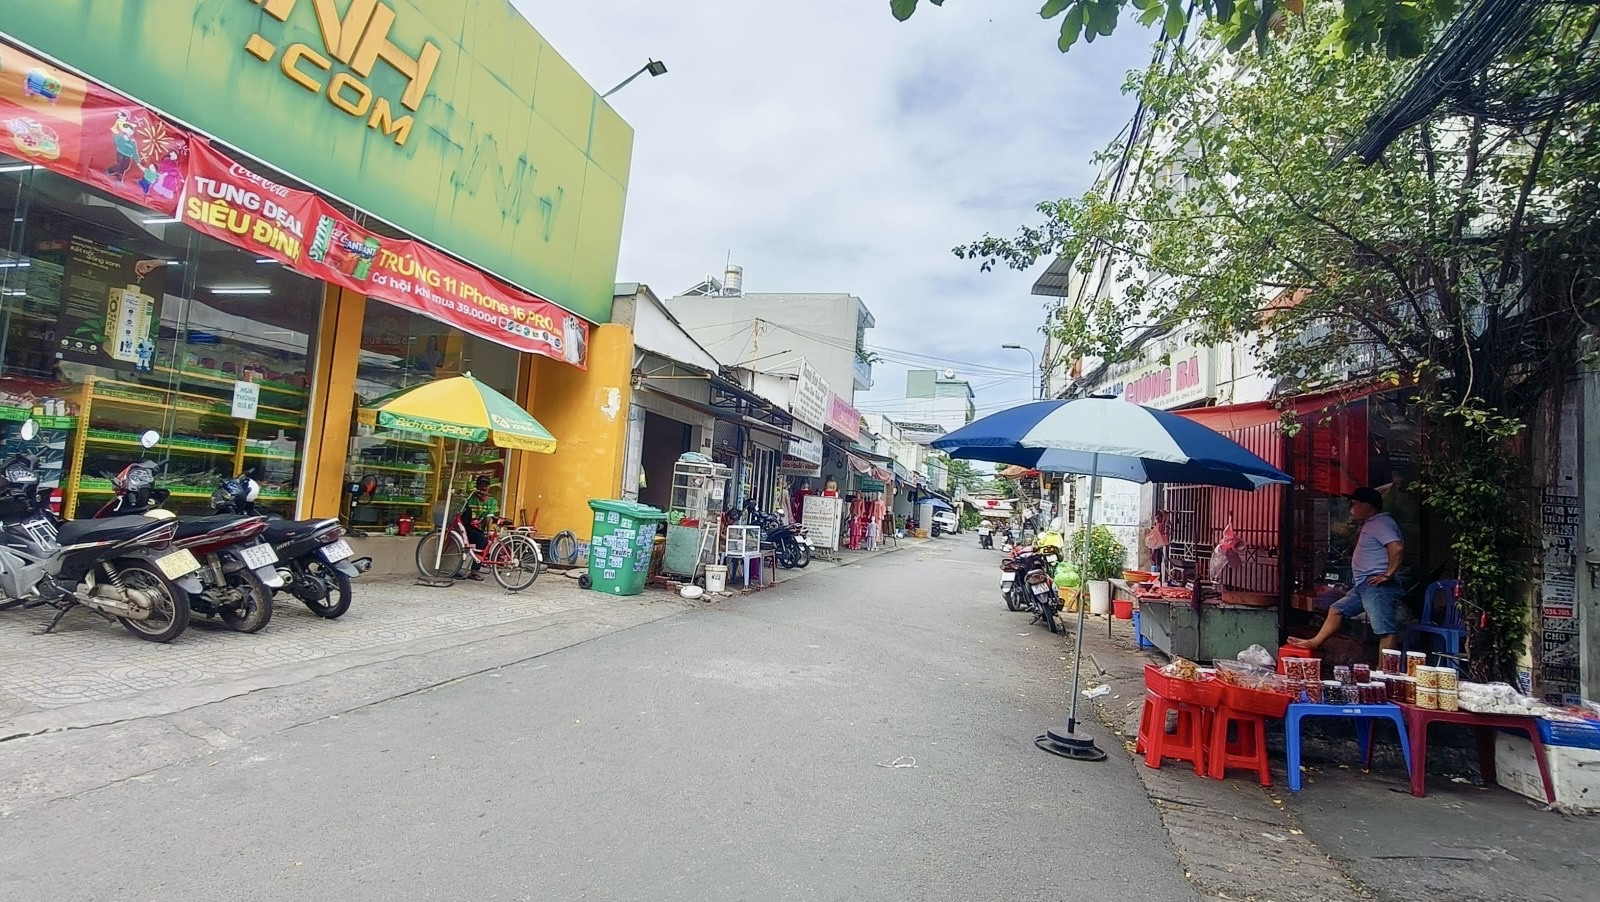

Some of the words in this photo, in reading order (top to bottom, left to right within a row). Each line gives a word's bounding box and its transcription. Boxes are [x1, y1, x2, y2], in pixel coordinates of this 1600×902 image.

[187, 196, 251, 234] SIÊU
[263, 200, 303, 238] DEAL
[379, 248, 441, 287] TRÚNG
[443, 276, 457, 294] 11
[460, 281, 509, 316] iPhone
[510, 305, 526, 321] 16
[526, 310, 554, 331] PRO
[431, 293, 454, 310] mua
[1175, 350, 1200, 392] BÁ
